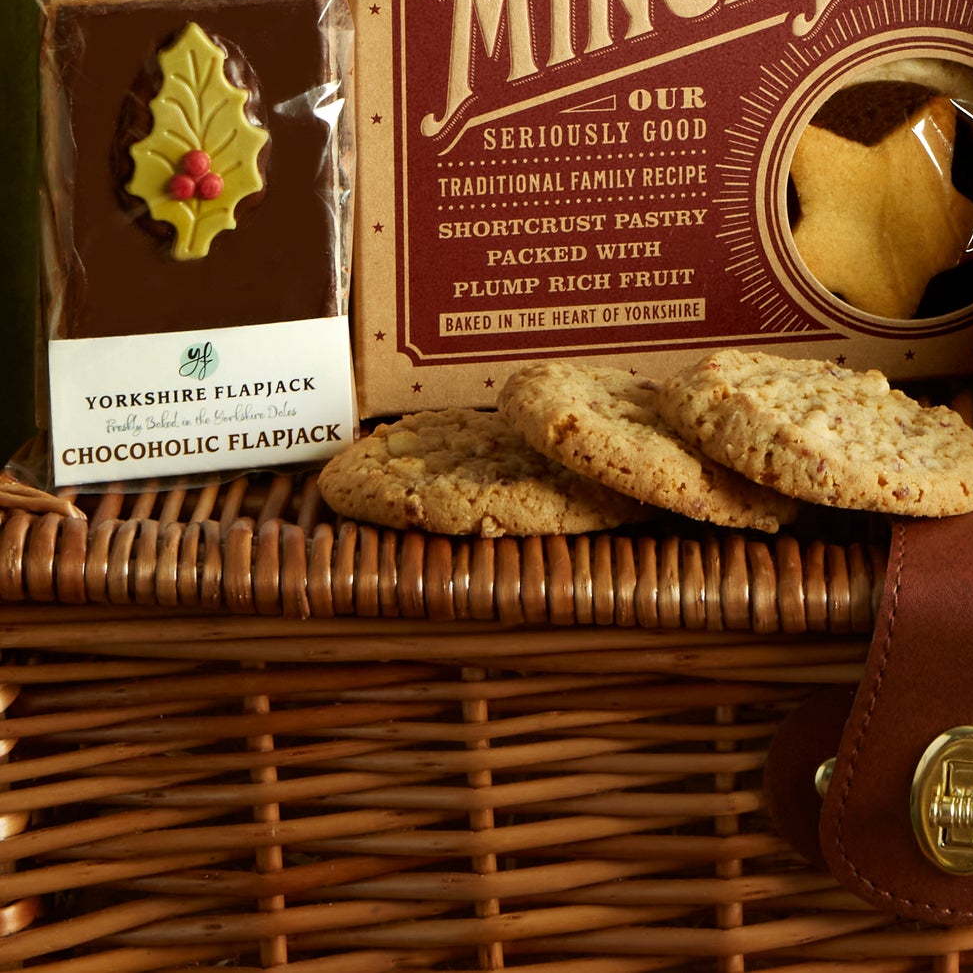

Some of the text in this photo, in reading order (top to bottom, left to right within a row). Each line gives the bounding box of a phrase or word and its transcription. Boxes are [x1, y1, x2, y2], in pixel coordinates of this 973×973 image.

[628, 86, 707, 111] OUR
[484, 118, 707, 150] SERIOUSLY GOOD
[438, 165, 708, 197] TRADITIONAL FAMILY RECIPE
[438, 209, 708, 239] SHORTCRUST PASTRY
[487, 241, 662, 266] PACKED WITH
[453, 269, 695, 298] PLUMP RICH FRUIT
[445, 302, 700, 332] BAKED IN THE HEART OF YORKSHIRE
[86, 377, 316, 410] YORKSHIRE FLAPJACK
[62, 424, 341, 466] CHOCOHOLIC FLAPJACK
